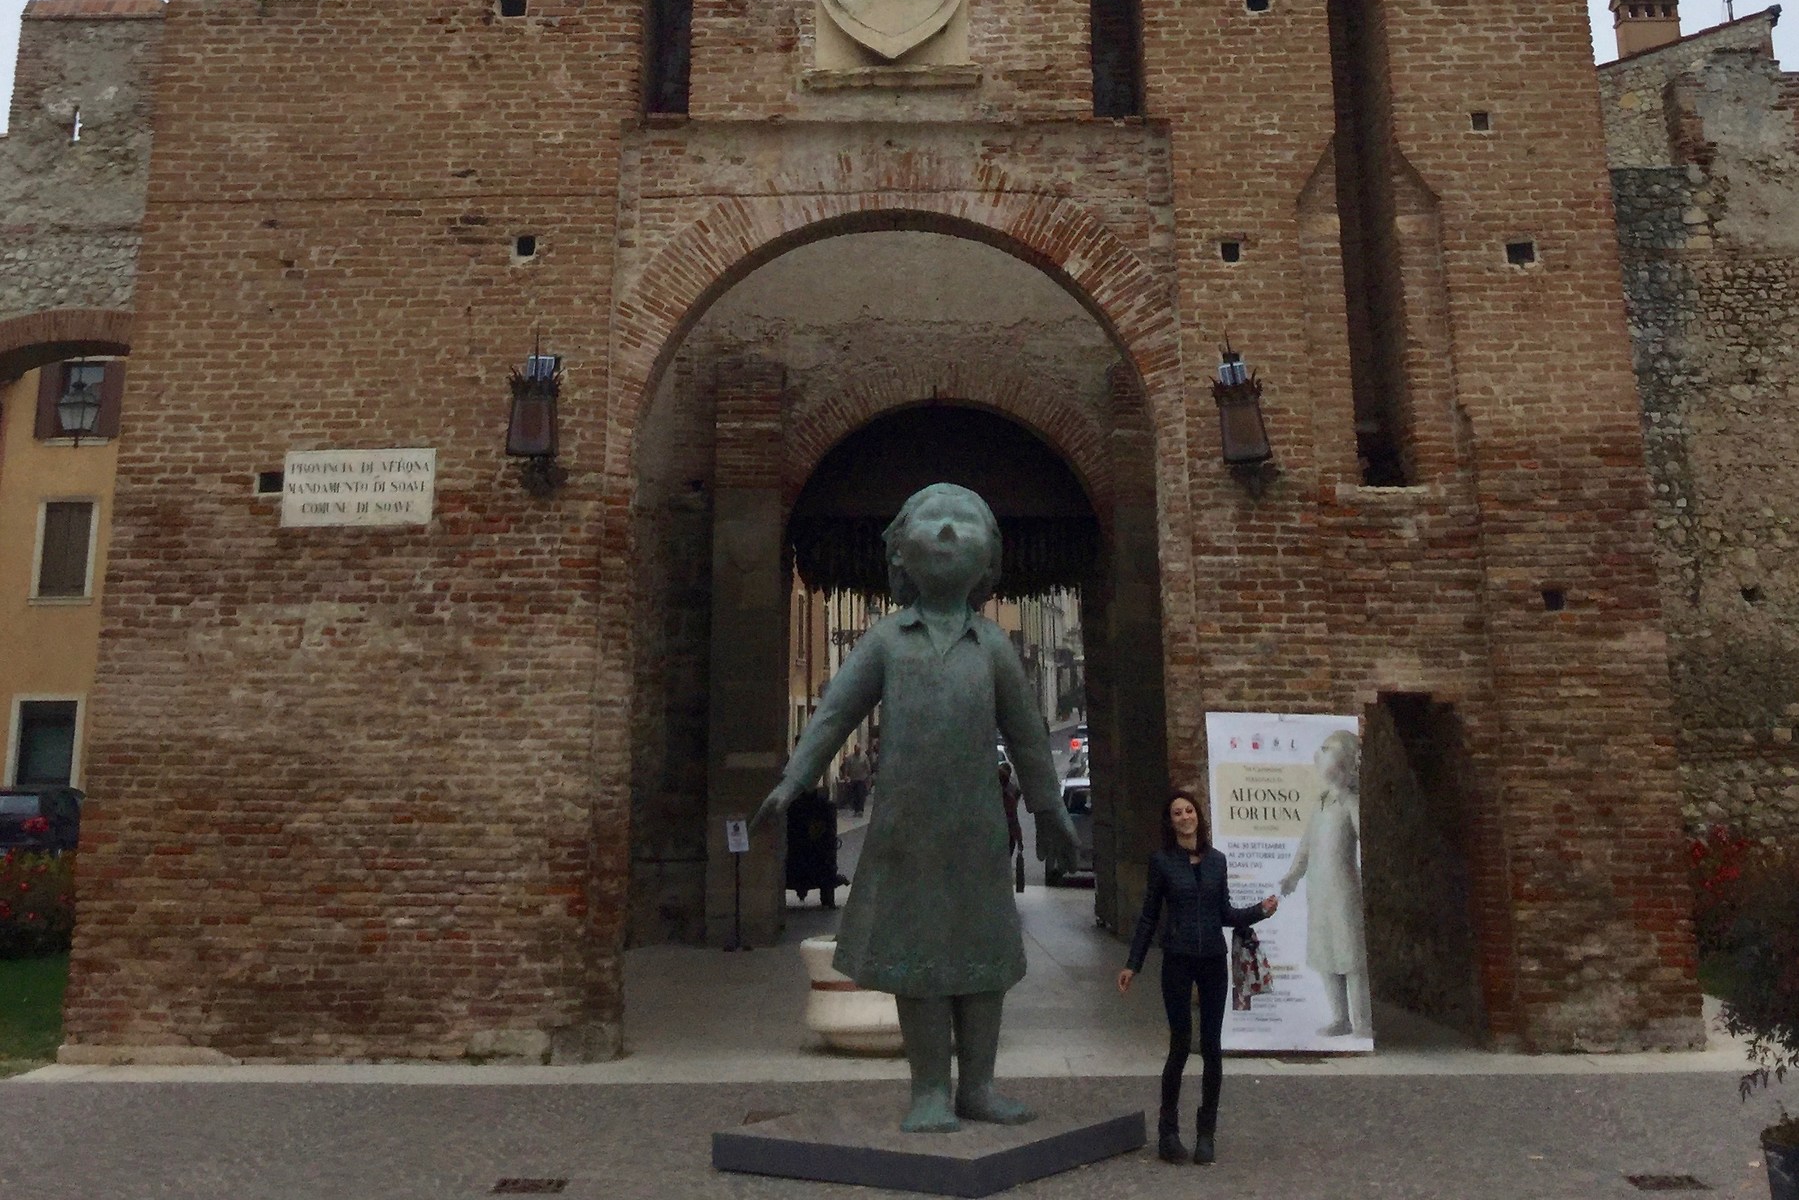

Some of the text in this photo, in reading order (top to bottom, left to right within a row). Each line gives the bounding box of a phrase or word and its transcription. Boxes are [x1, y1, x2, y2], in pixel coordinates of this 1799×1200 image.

[291, 459, 430, 475] PROVINCIA DI VERONA
[289, 480, 426, 495] MANDAMENTO DI SOAVE
[302, 501, 414, 514] COMUNE DI SOAVE
[1231, 787, 1301, 803] ALFONSO
[1230, 805, 1302, 821] FORTUNA
